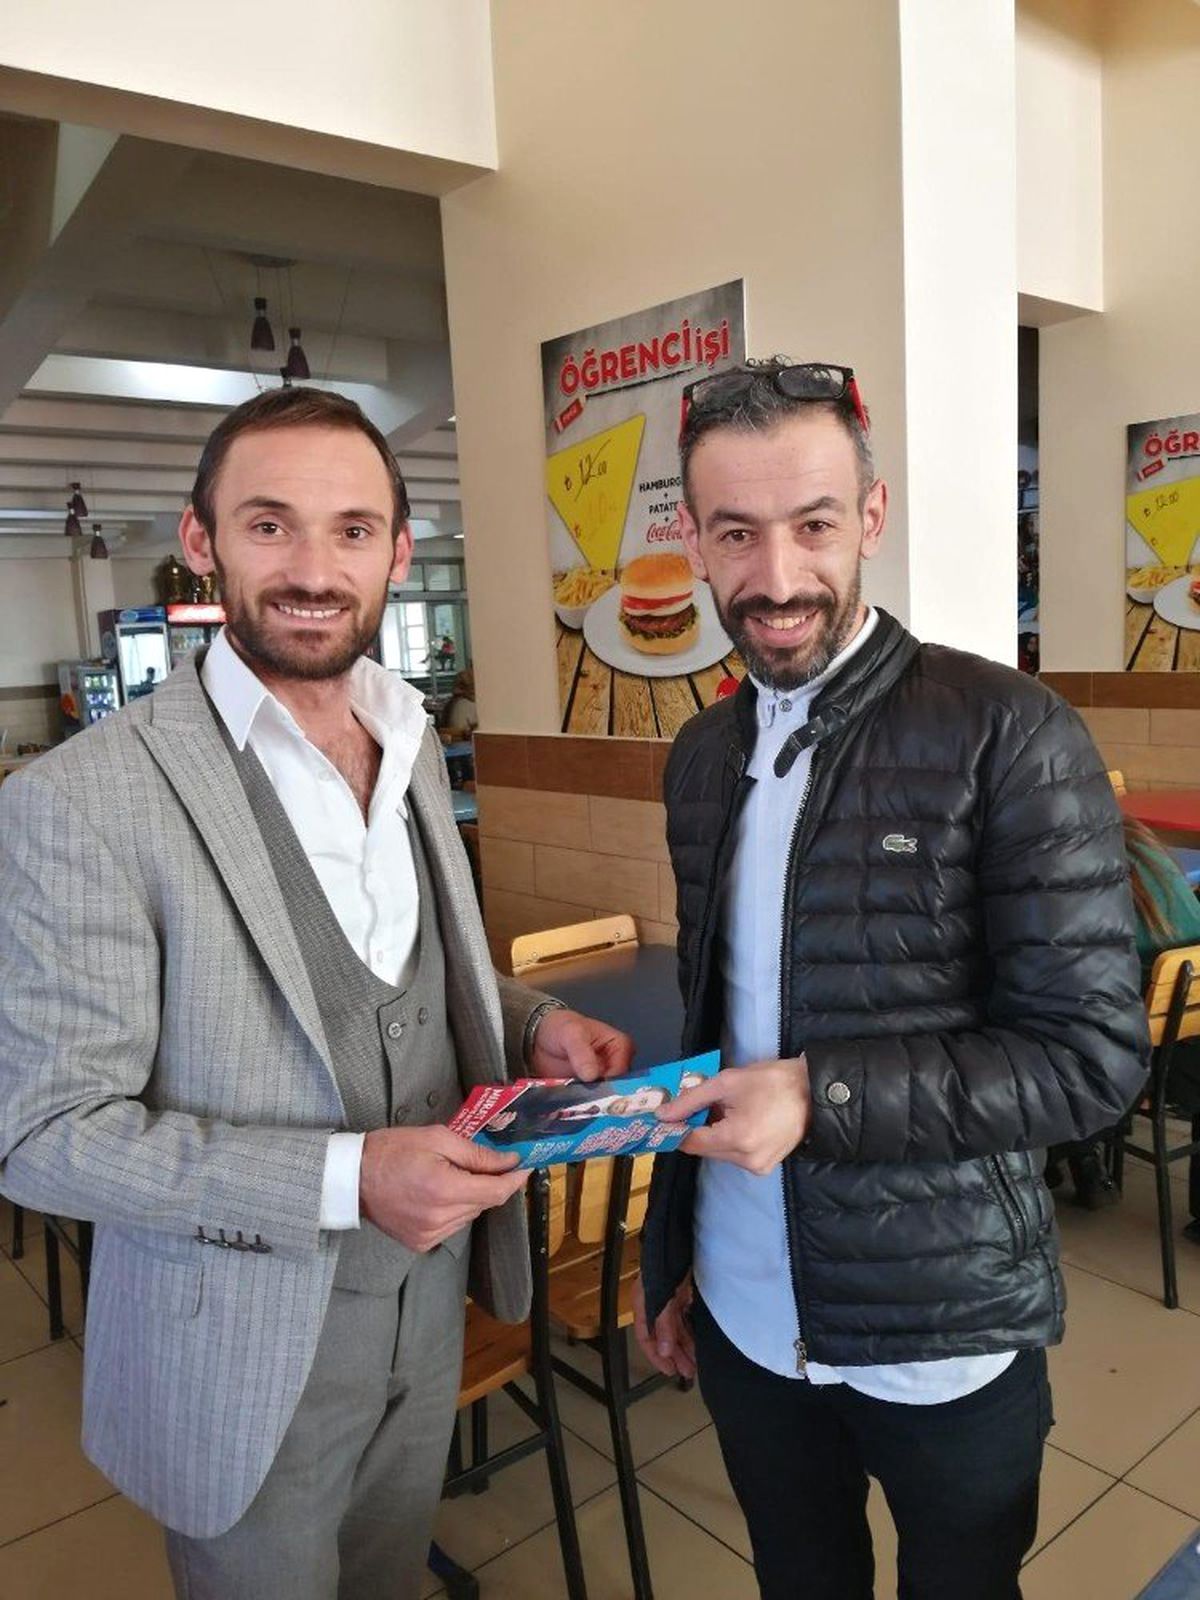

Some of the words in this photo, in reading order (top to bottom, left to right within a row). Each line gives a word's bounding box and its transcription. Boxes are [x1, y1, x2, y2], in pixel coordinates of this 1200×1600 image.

[560, 319, 691, 395] ÖĞRENCİ
[1144, 429, 1200, 457] ÖĞR
[639, 476, 682, 492] HAMBURG
[648, 500, 684, 514] PATATE
